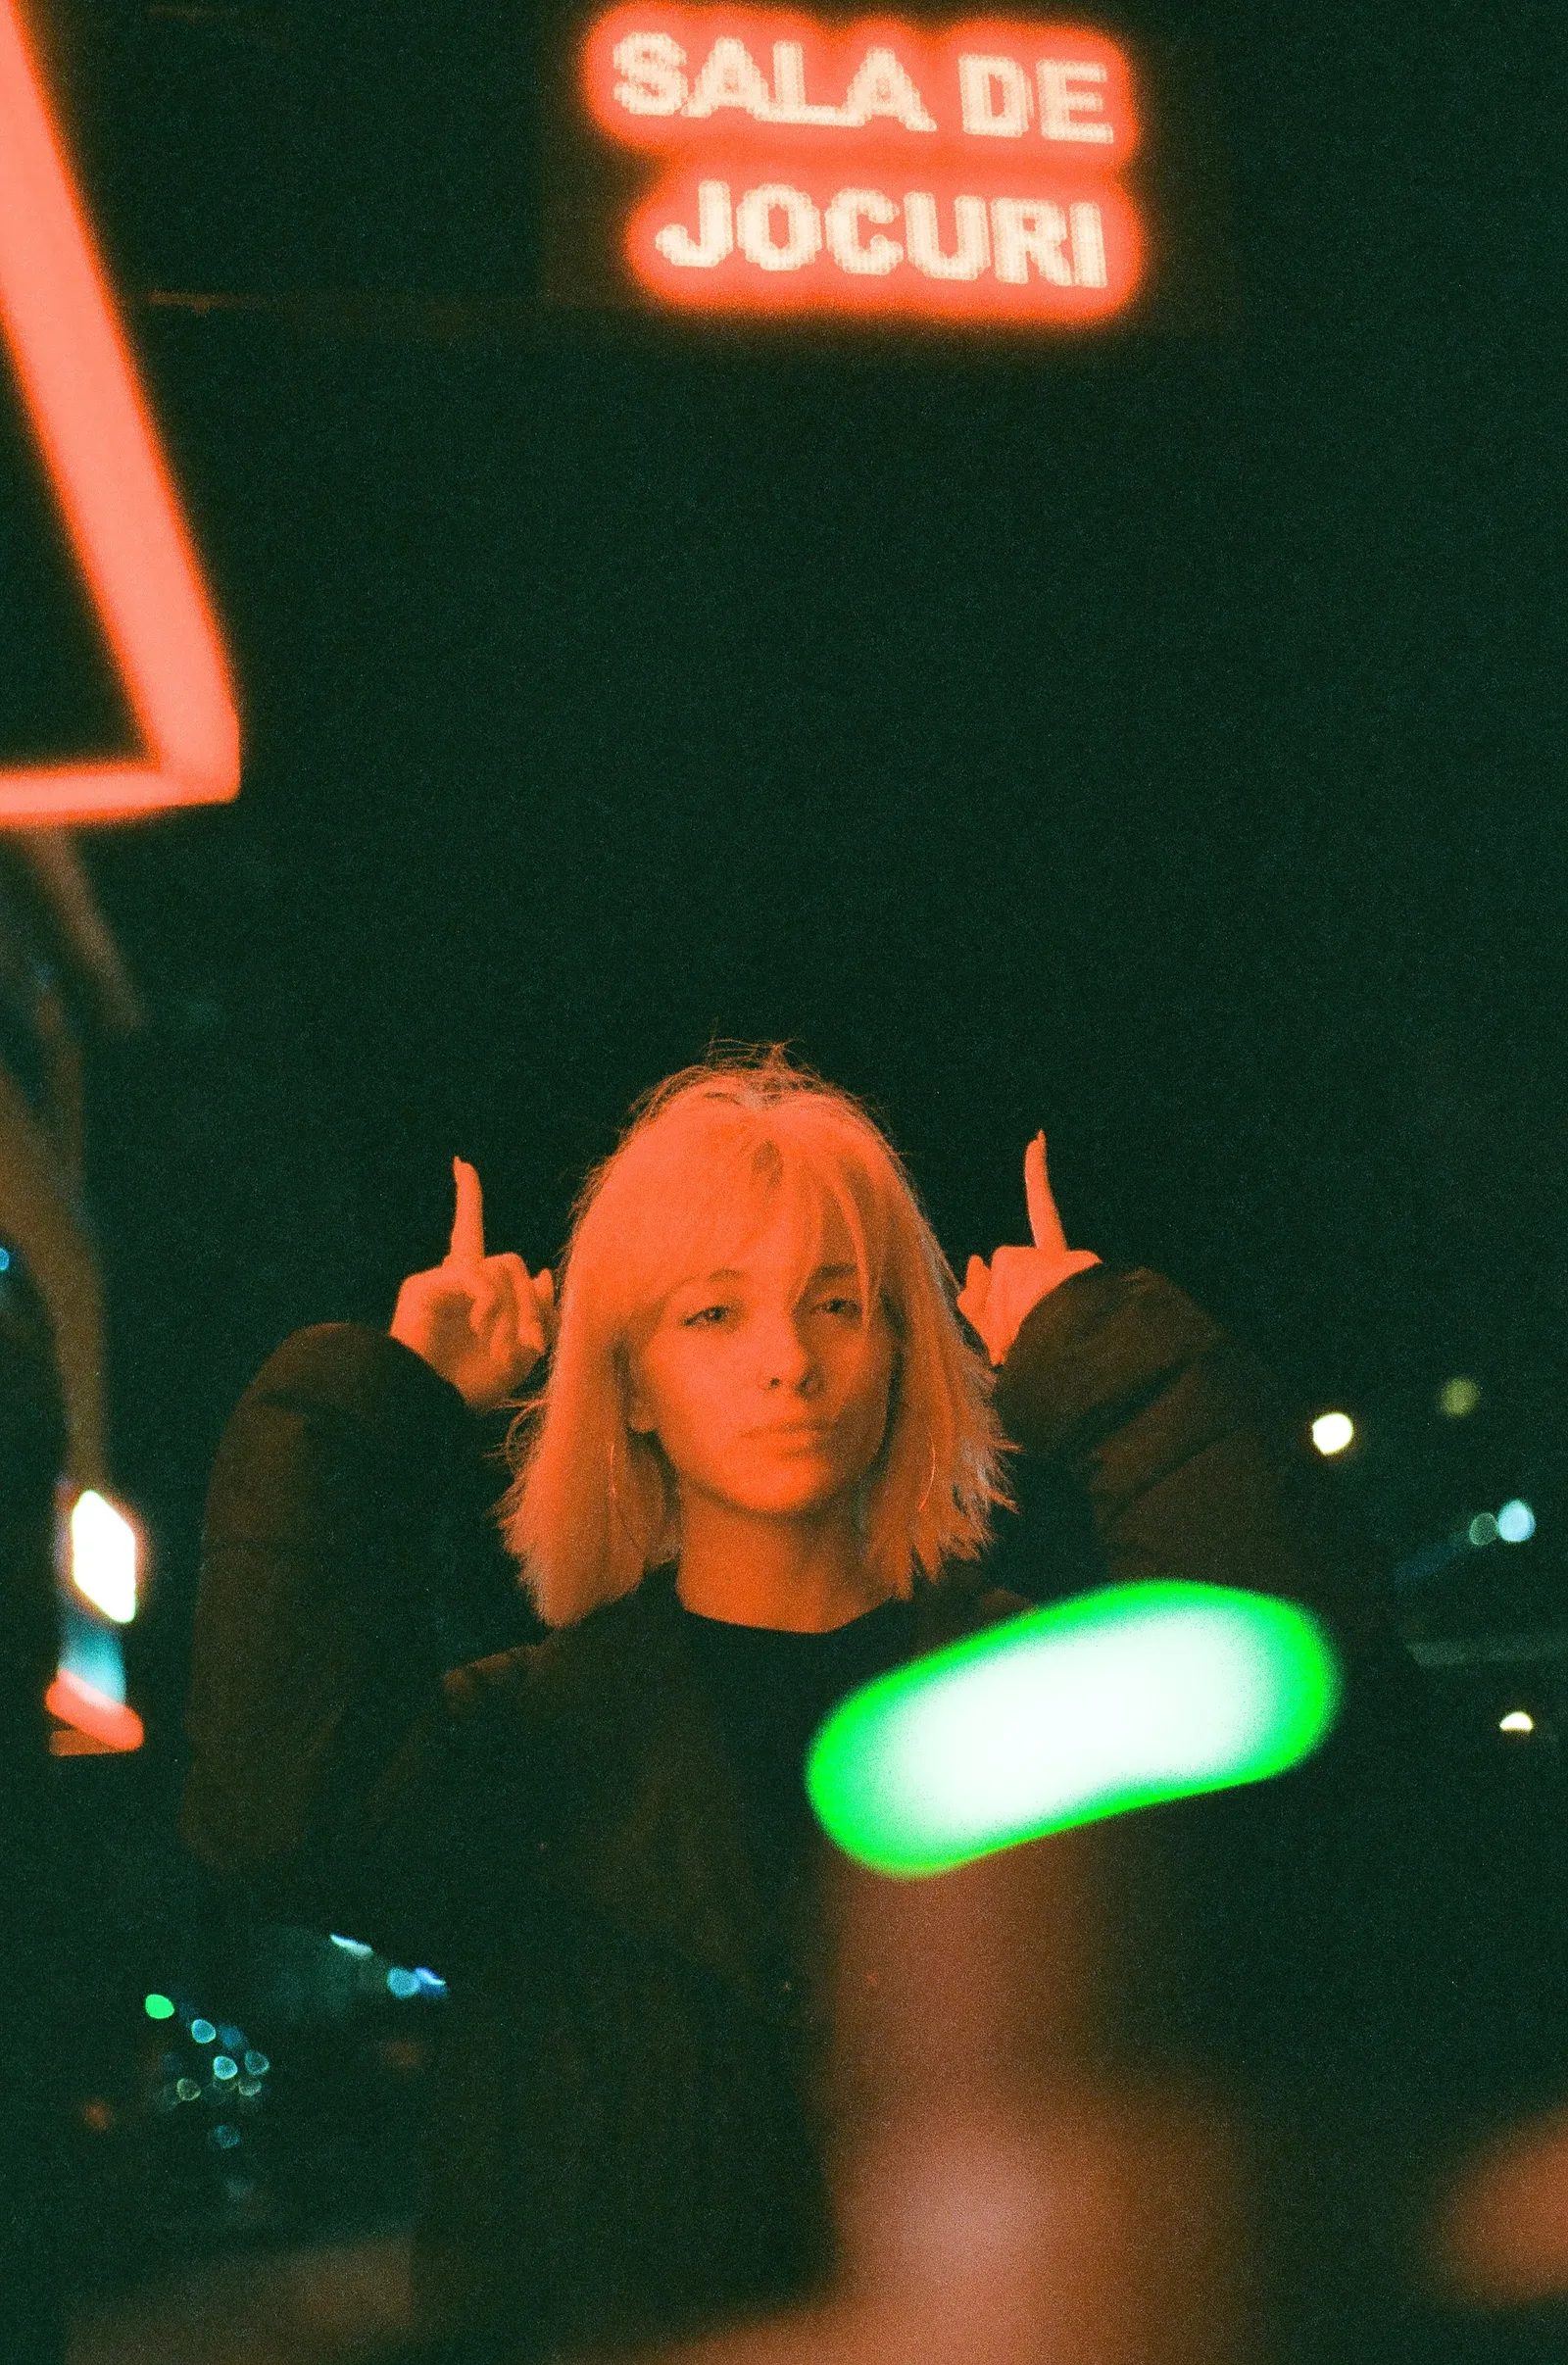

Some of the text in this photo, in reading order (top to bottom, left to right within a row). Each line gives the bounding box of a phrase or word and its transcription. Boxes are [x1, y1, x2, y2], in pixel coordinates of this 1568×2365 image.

[613, 31, 1114, 143] SALA DE
[655, 179, 1107, 287] JOCURI
